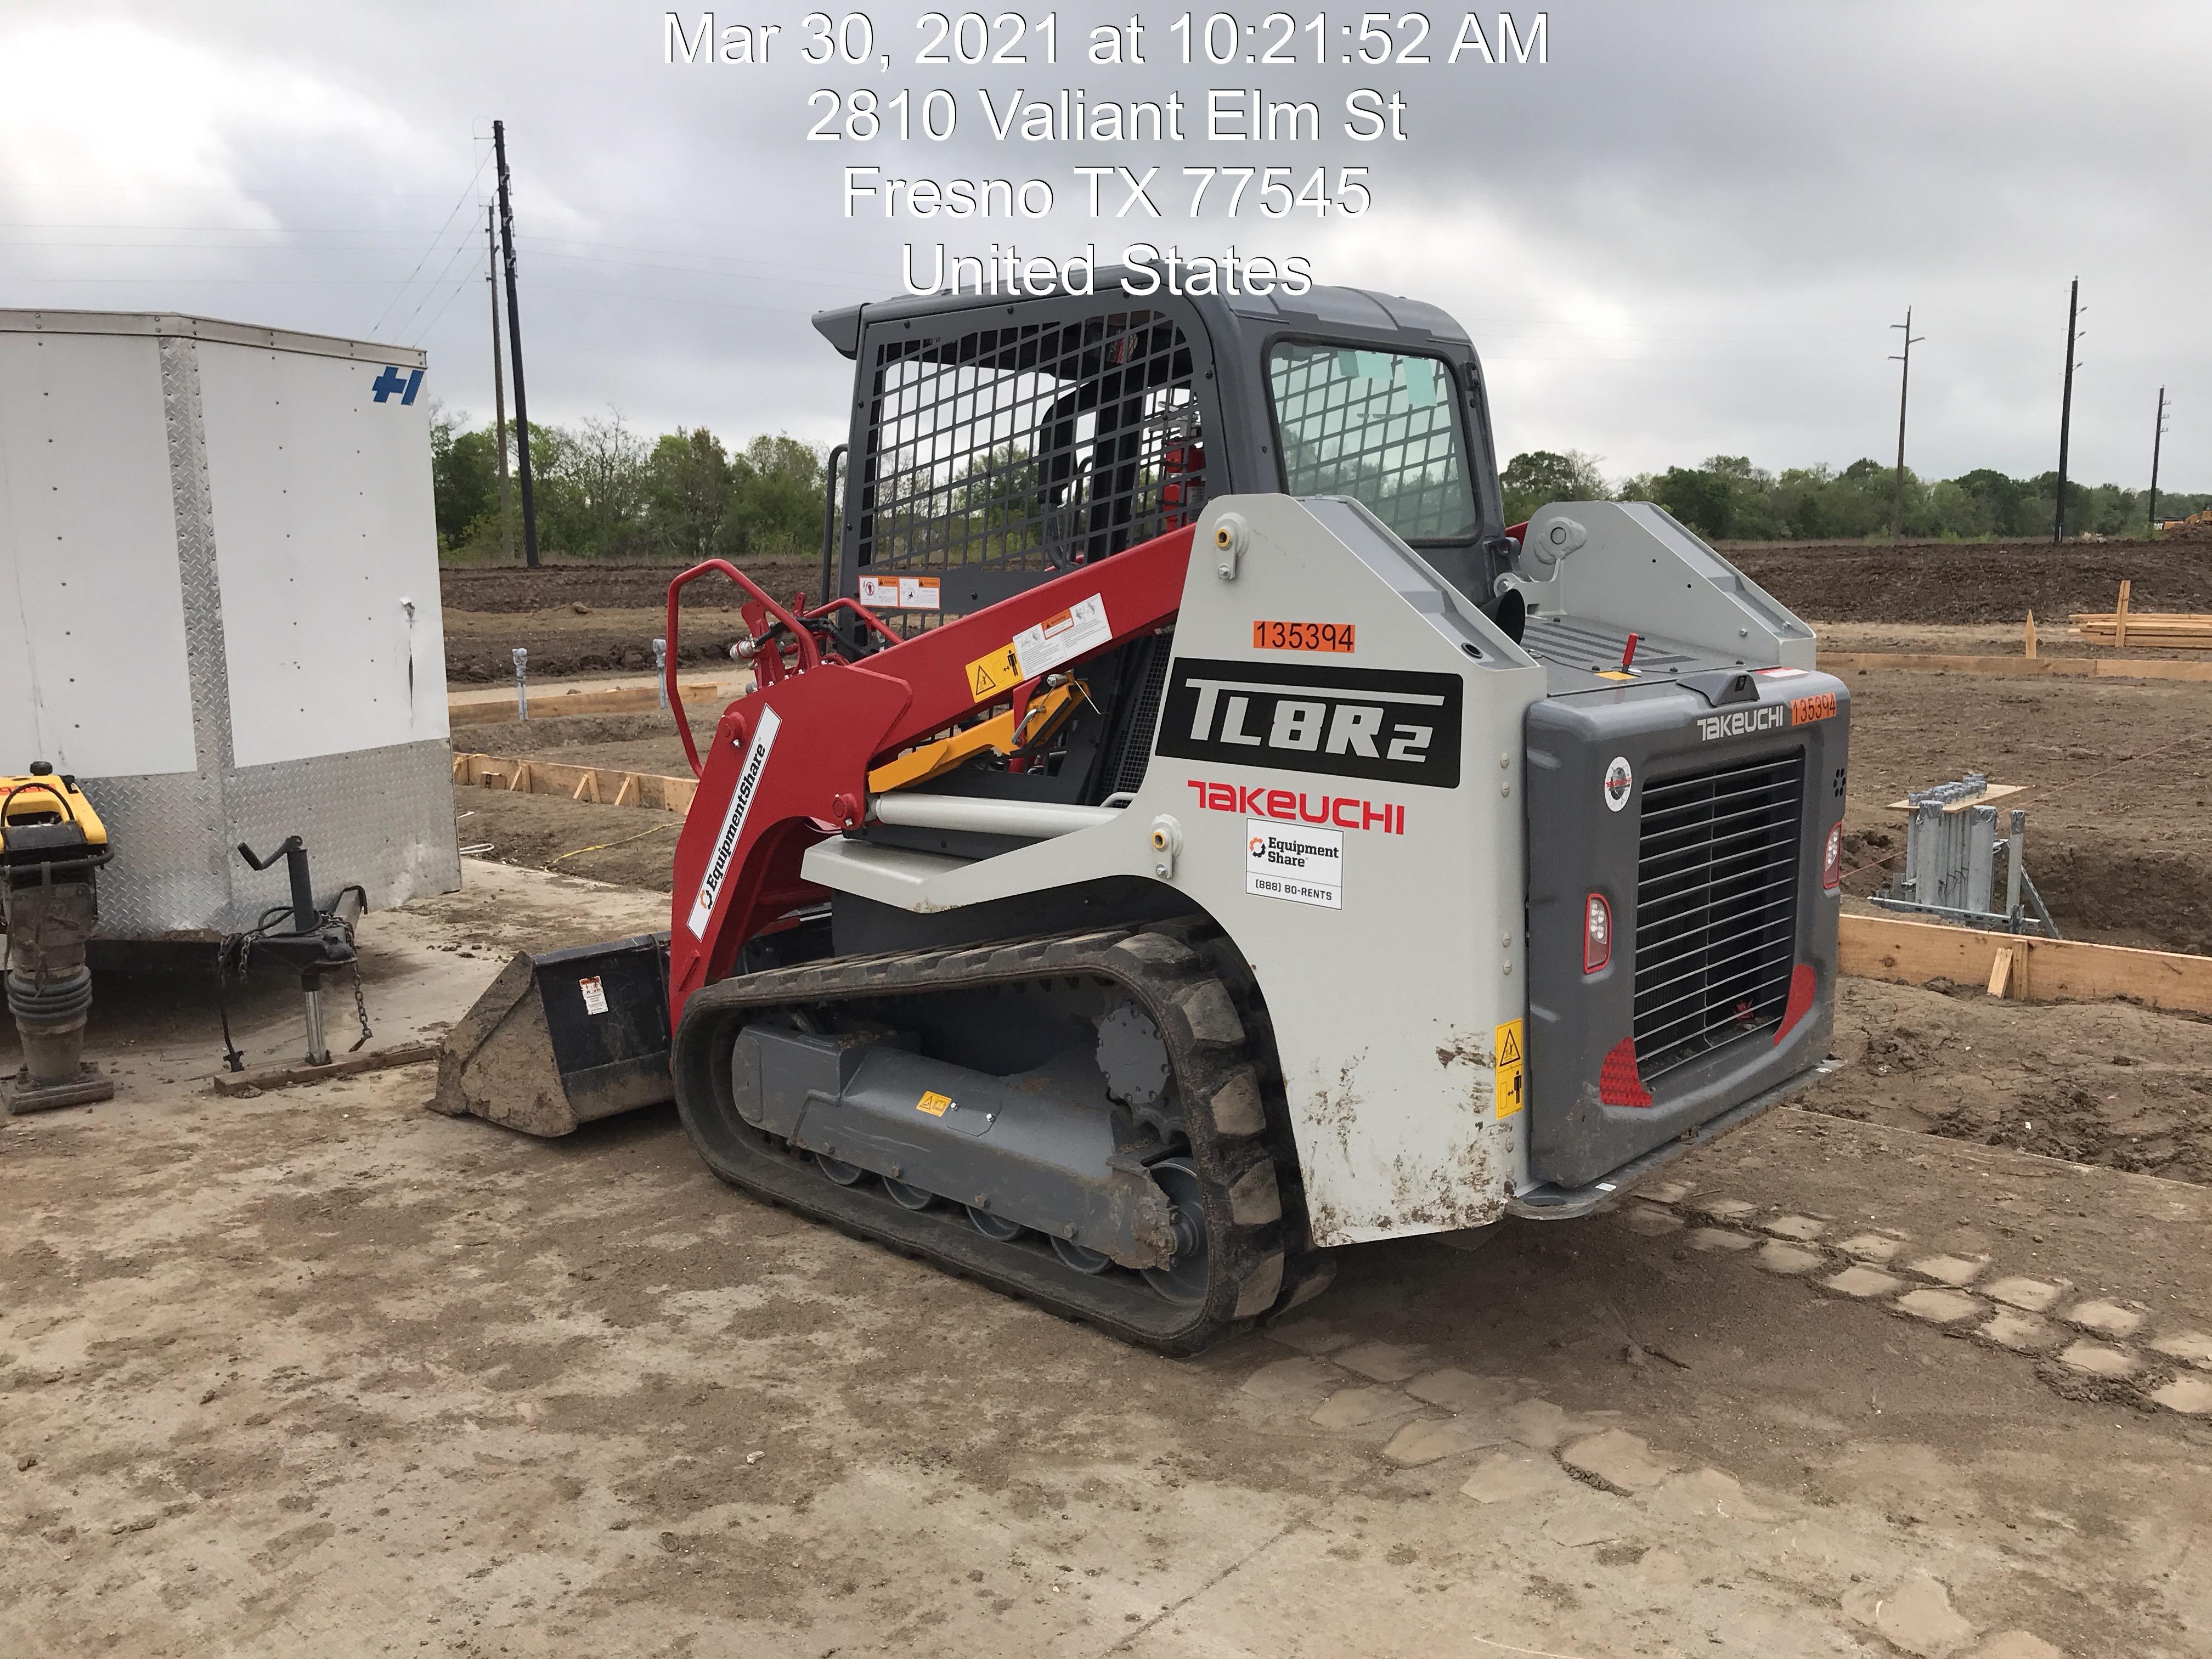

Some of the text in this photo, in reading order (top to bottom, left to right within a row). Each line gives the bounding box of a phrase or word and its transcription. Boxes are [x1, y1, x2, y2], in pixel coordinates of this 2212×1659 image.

[1257, 621, 1353, 651] 135394
[1185, 678, 1445, 763] TL8R2
[1793, 693, 1836, 724] 135394
[706, 743, 766, 893] EquipmentShare
[1268, 837, 1339, 858] Equipment
[1256, 879, 1332, 900] (888) 80-RENTS
